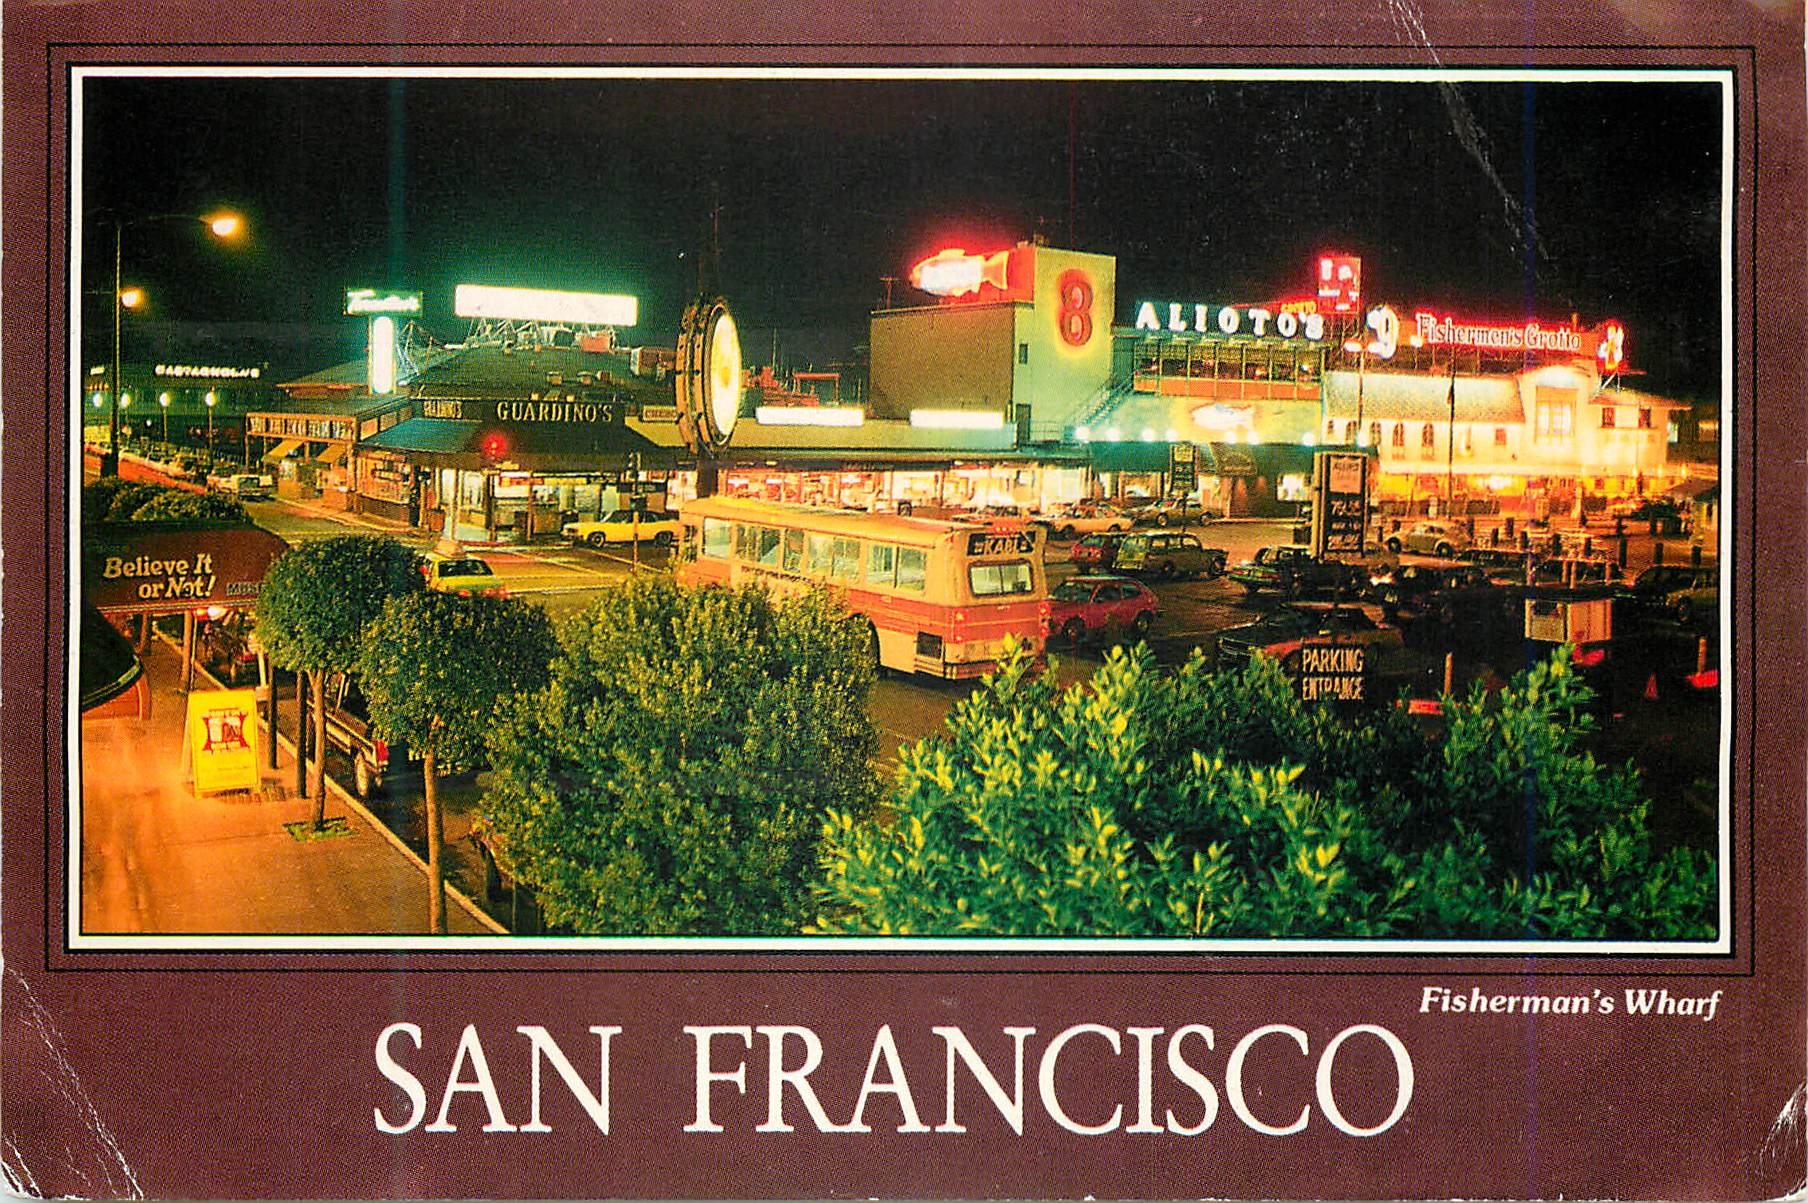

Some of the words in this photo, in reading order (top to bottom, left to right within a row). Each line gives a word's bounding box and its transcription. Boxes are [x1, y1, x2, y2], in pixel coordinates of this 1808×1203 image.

[1059, 277, 1095, 348] 8
[1135, 300, 1324, 340] ALIOTO'S
[1524, 323, 1582, 351] Grotto
[496, 401, 613, 423] GUARDINO'S
[103, 555, 189, 578] Believe
[193, 553, 213, 575] It
[138, 580, 164, 599] or
[164, 575, 216, 598] Not!
[1302, 648, 1365, 673] PARKING
[1302, 676, 1365, 700] ENTRANCE
